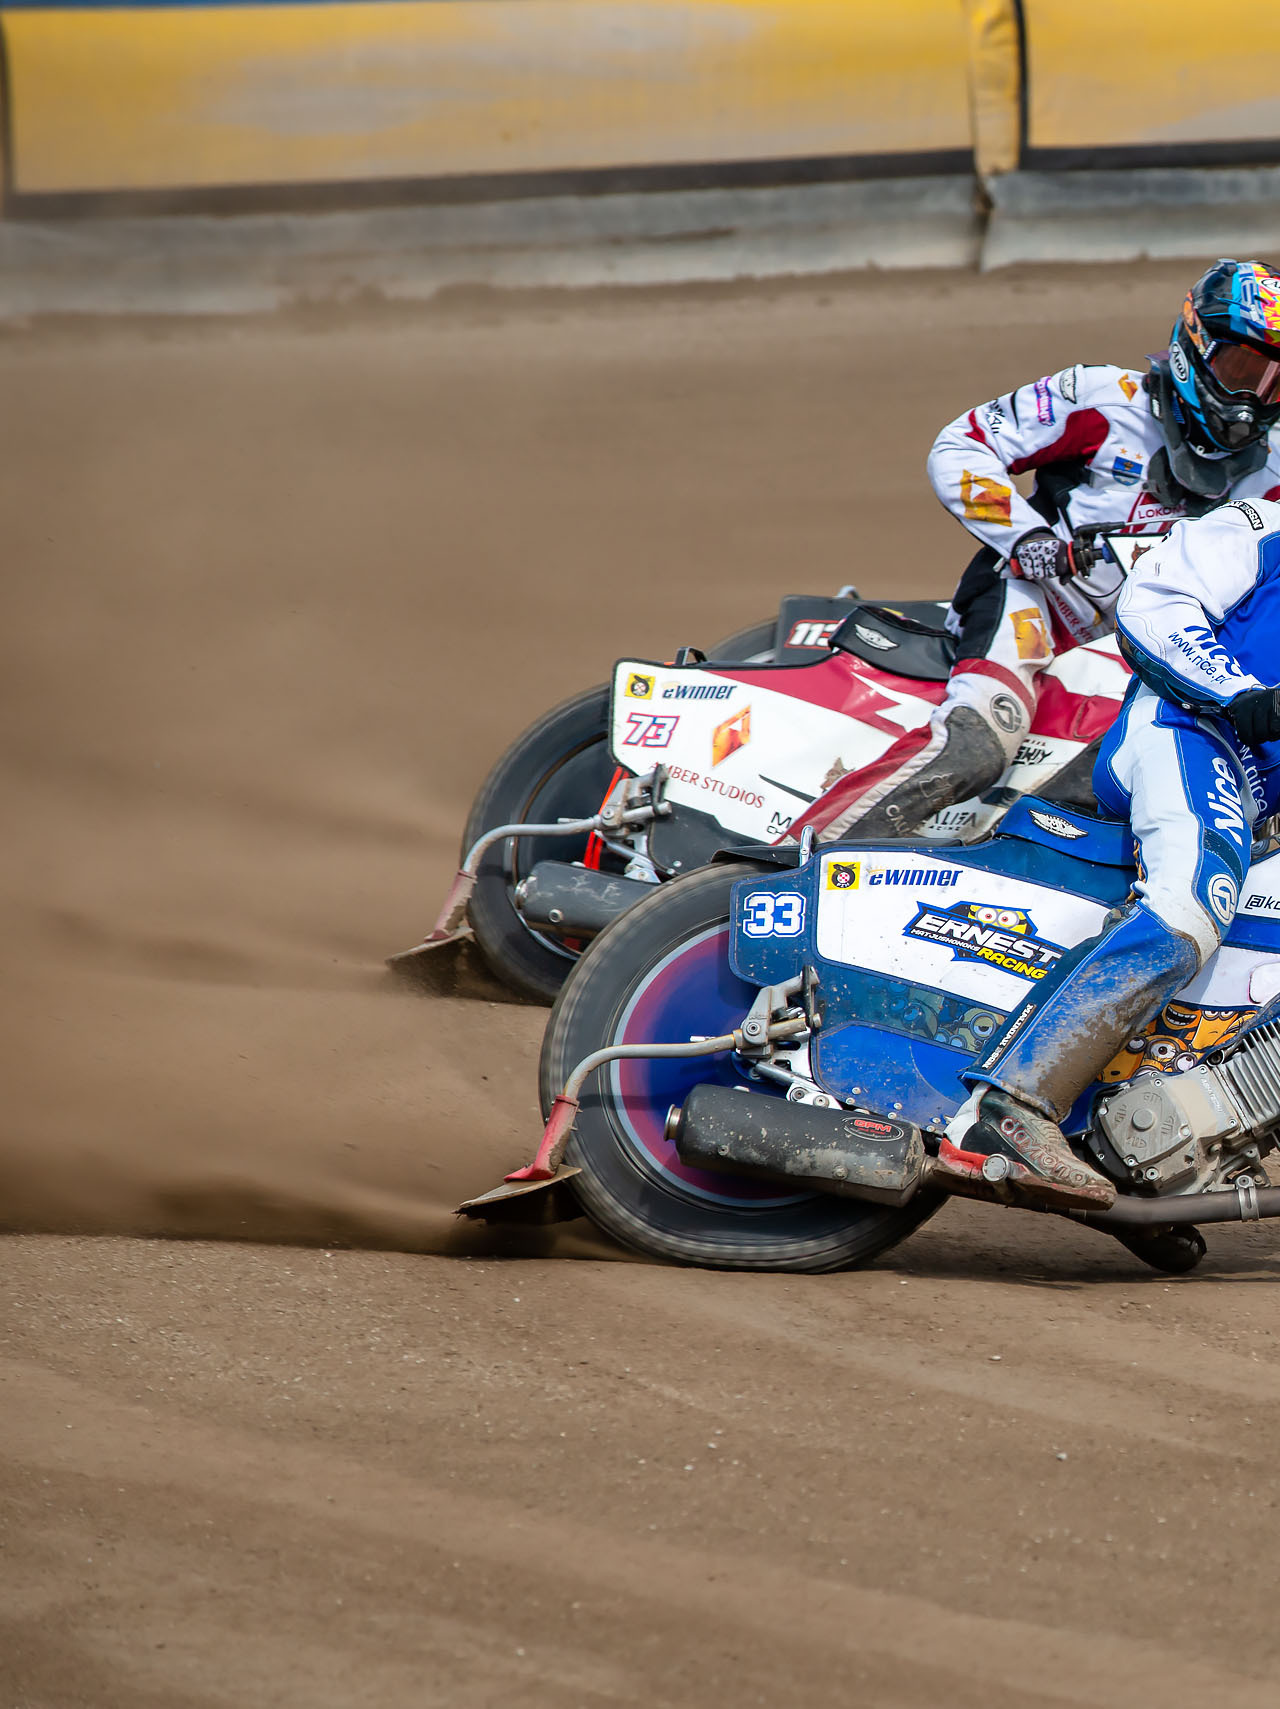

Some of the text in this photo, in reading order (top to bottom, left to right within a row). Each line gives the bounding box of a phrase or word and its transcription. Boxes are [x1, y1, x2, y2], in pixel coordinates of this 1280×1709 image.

[1171, 346, 1187, 381] Arai
[622, 712, 680, 748] 73
[701, 776, 765, 808] STUDIOS
[1207, 757, 1244, 847] Nice
[743, 892, 806, 938] 33
[914, 913, 1063, 963] ERNEST
[977, 947, 1049, 980] RACING
